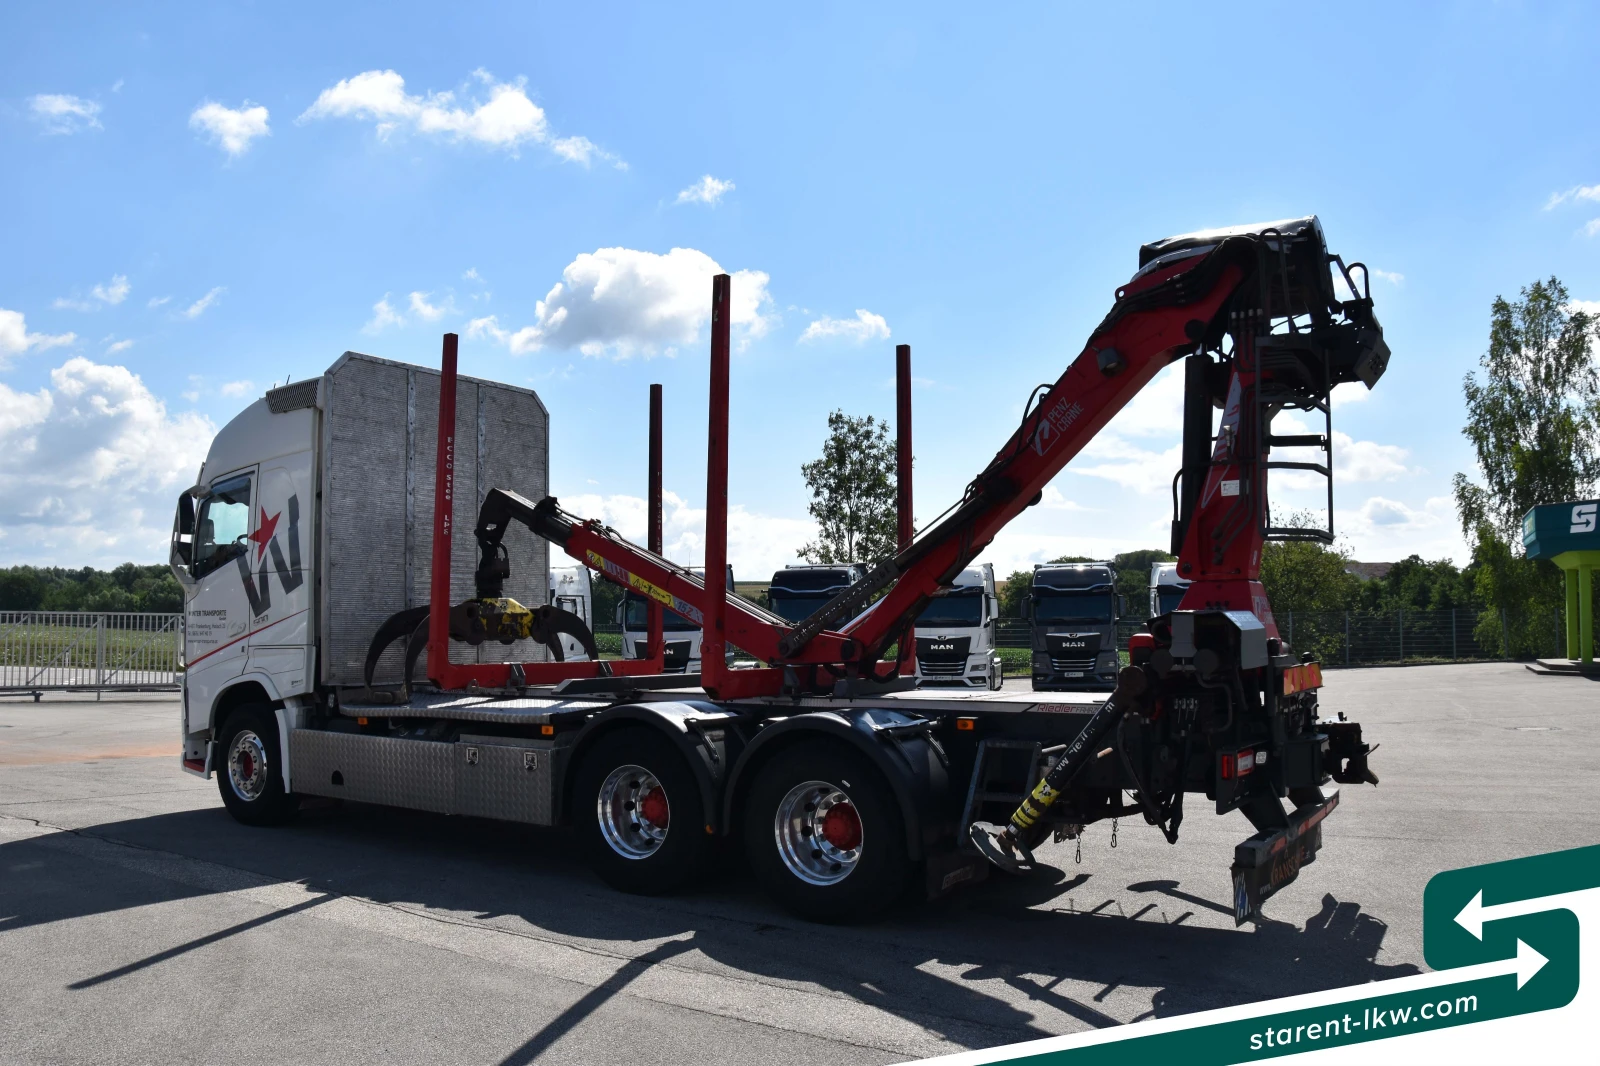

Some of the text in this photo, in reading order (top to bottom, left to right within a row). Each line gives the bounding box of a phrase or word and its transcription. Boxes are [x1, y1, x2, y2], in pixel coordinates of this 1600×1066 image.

[1048, 396, 1071, 423] PENZ
[1056, 401, 1084, 432] CRANE
[201, 609, 227, 617] TRANSPORTE
